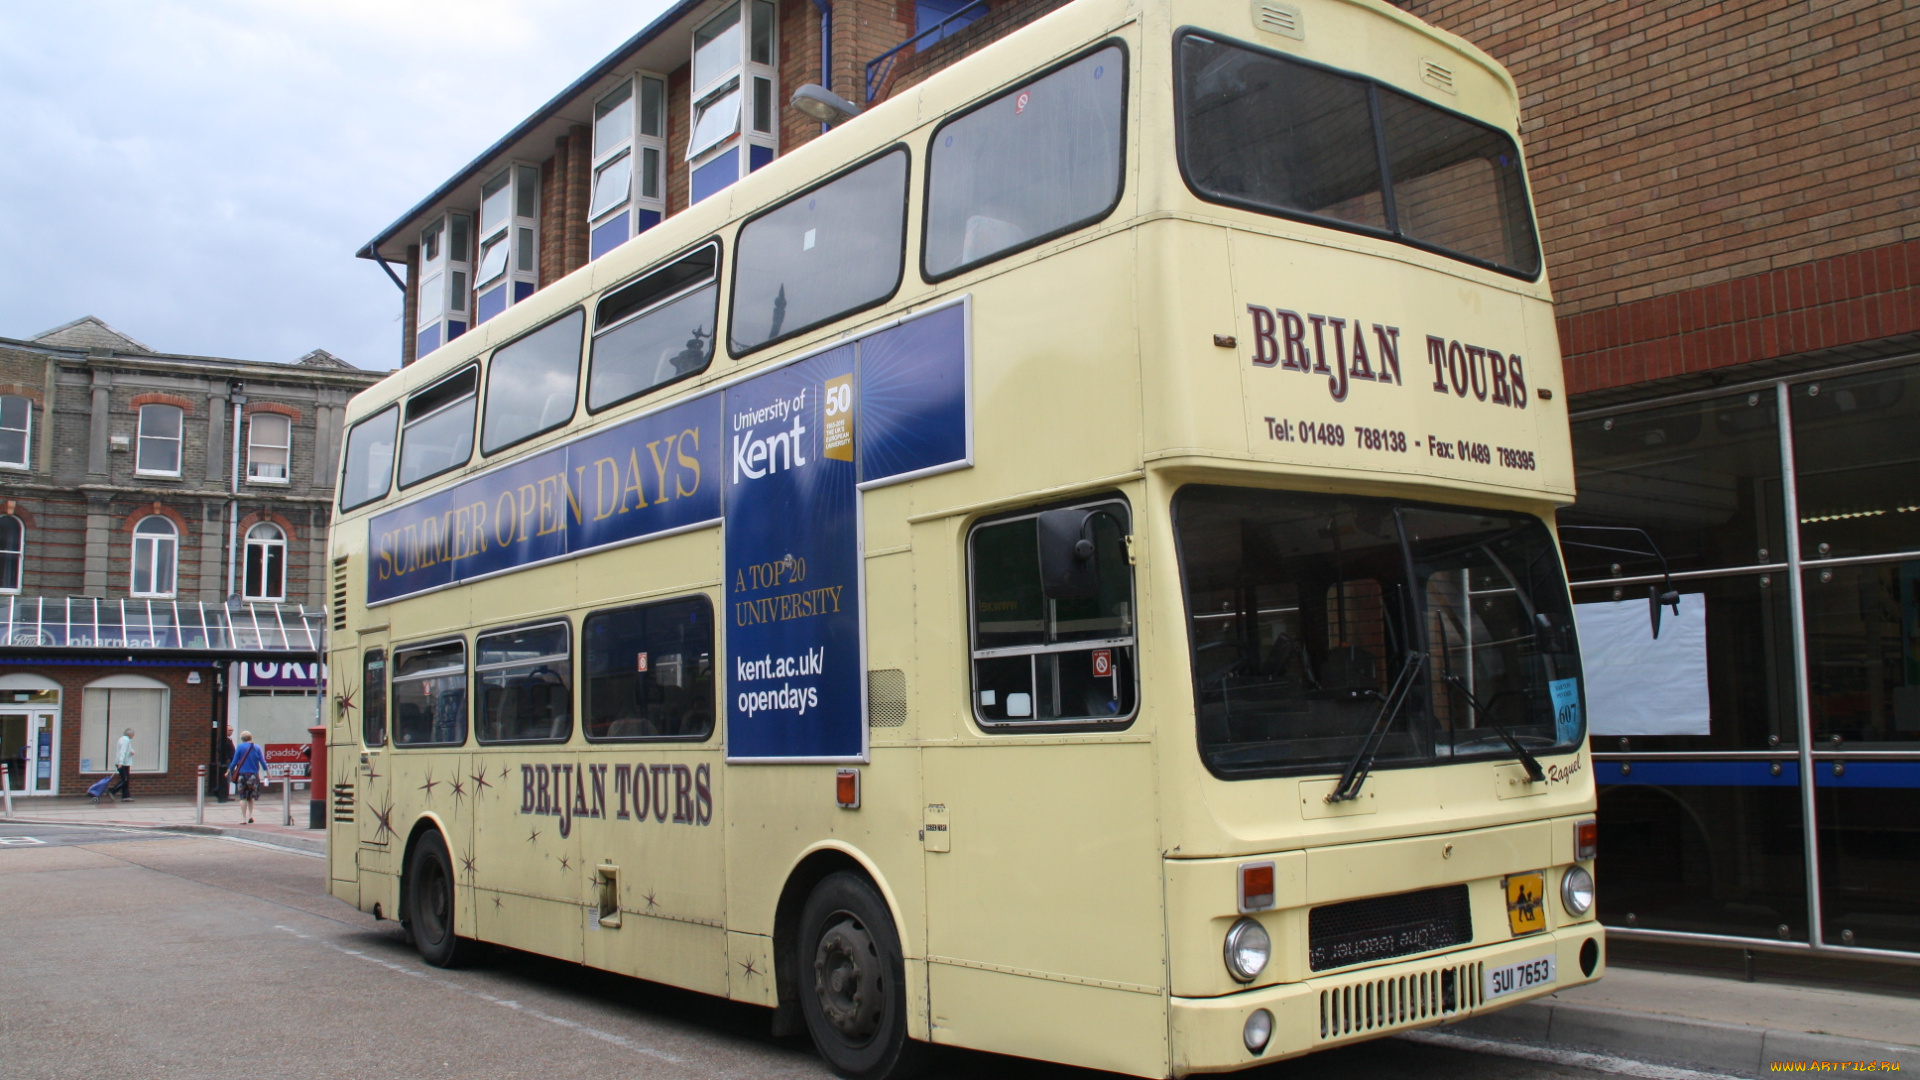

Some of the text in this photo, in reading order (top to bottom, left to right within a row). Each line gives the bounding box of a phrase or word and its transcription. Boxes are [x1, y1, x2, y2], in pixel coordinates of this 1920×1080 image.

[1247, 303, 1527, 410] BRIJAN TOURS
[734, 388, 806, 431] University of
[826, 383, 851, 417] 50
[733, 414, 806, 485] Kent
[1264, 416, 1295, 442] Tel:
[1298, 420, 1345, 447] 01489
[1354, 426, 1407, 453] 788138
[1428, 434, 1454, 459] Fax:
[1457, 439, 1491, 465] 01489
[1496, 446, 1535, 471] 789395
[378, 426, 701, 581] SUMMER OPEN DAYS
[735, 557, 806, 592] A TOP 20
[735, 585, 843, 627] UNIVERSITY
[69, 635, 161, 648] pharmacy
[737, 645, 824, 682] kent.ac.uk/
[738, 683, 818, 718] opendays
[1559, 703, 1576, 724] 607
[266, 748, 302, 760] goadsby
[1548, 752, 1581, 786] Raquel
[520, 762, 713, 839] BRIJAN TOURS
[1493, 959, 1549, 994] SUI 7653
